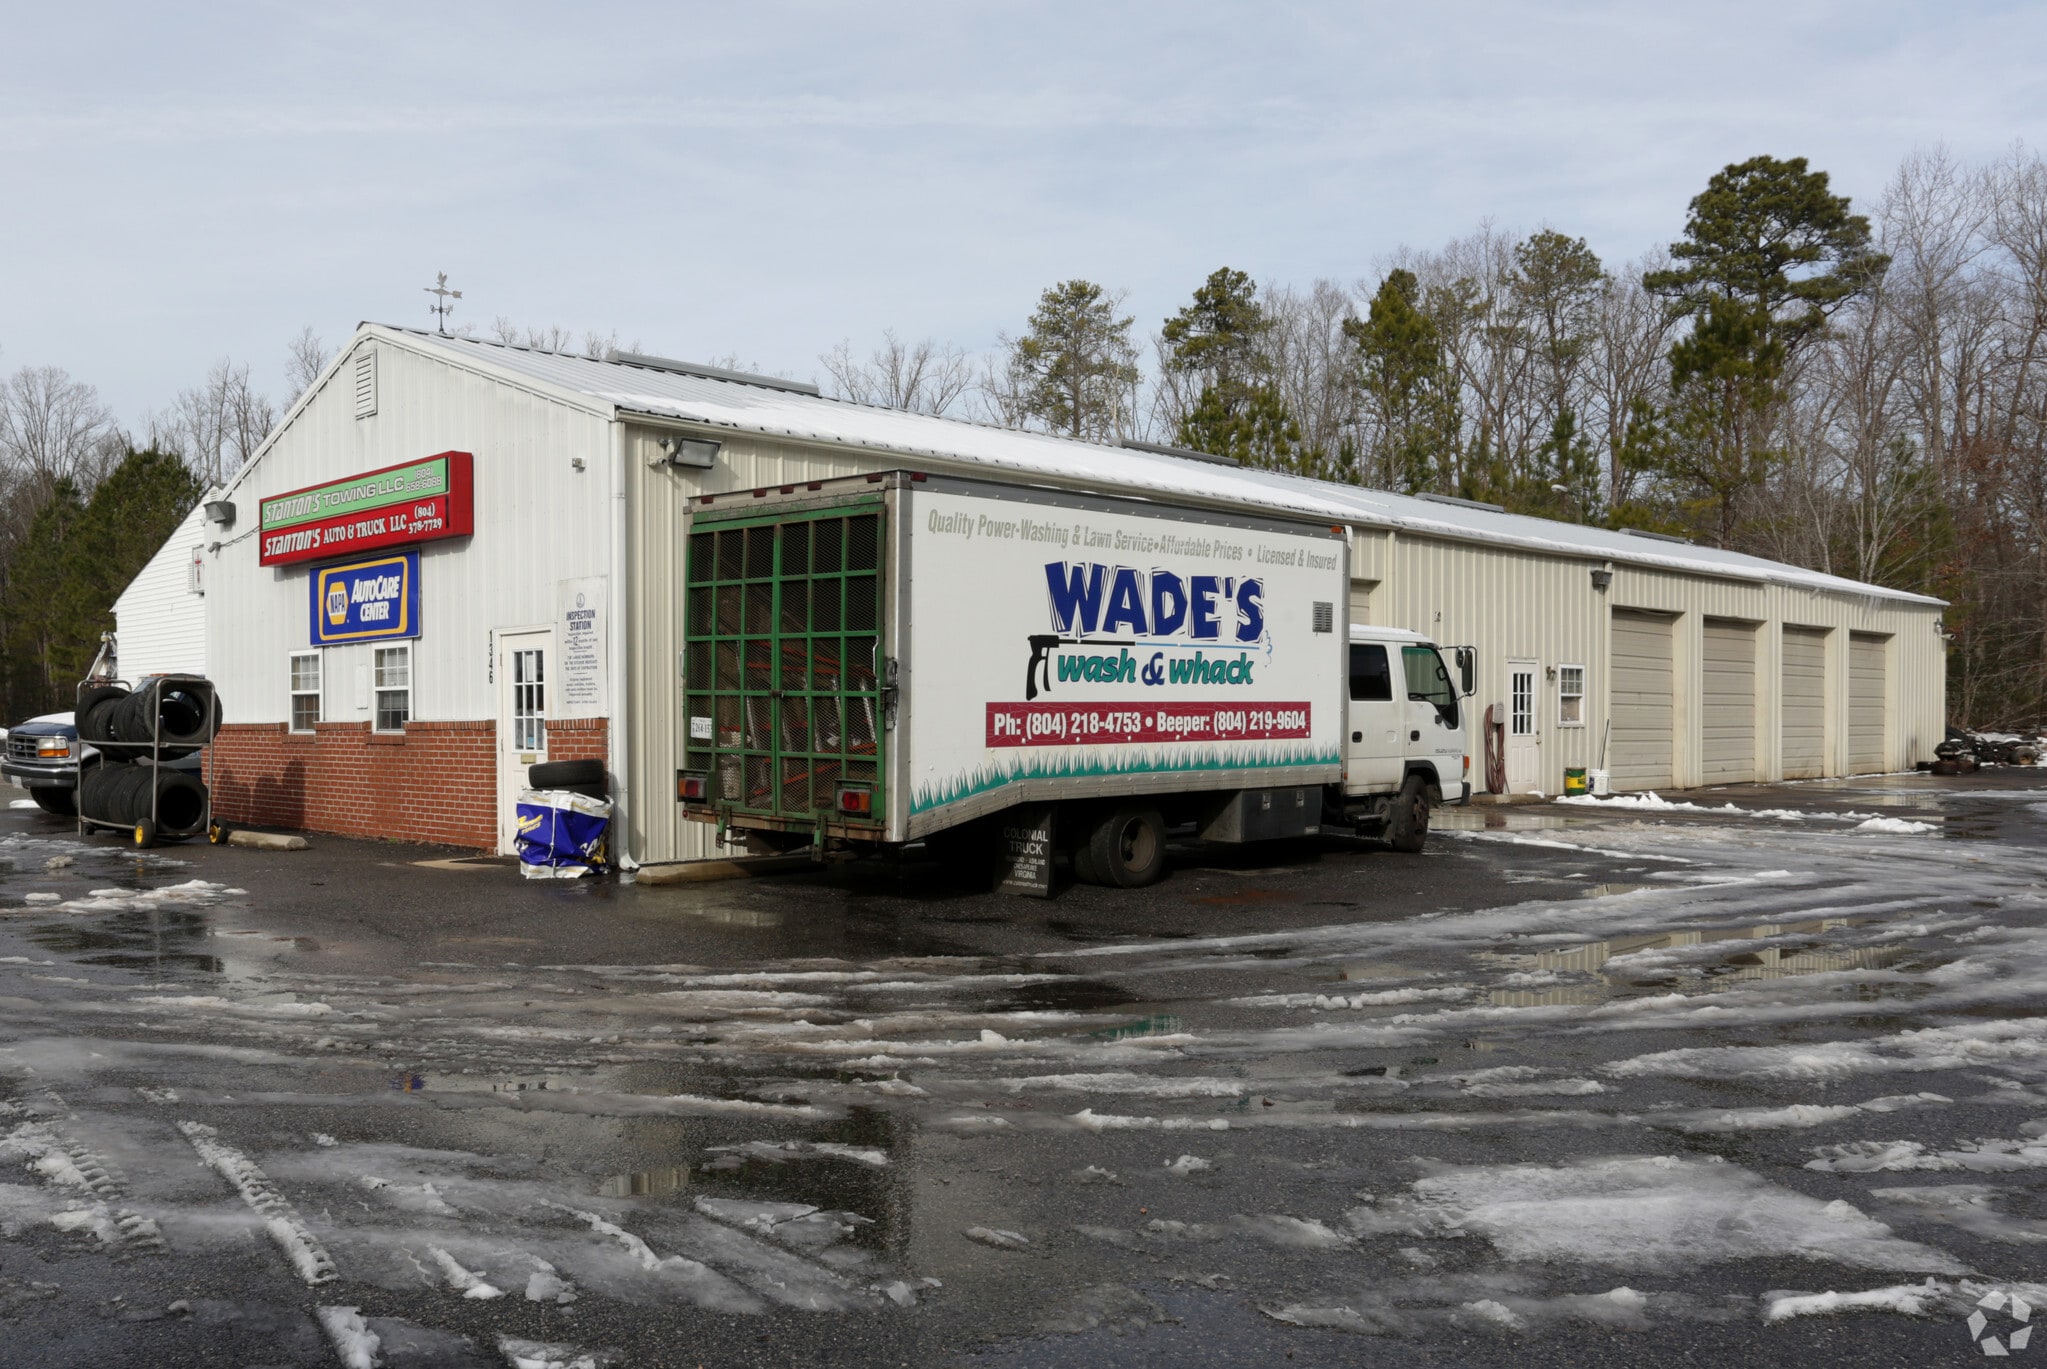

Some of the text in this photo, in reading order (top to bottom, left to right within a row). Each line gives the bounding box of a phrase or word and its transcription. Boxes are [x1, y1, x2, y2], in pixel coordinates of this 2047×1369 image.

[322, 484, 376, 507] TOWING
[378, 477, 405, 496] LLC
[414, 502, 435, 519] (804)
[323, 525, 345, 545] AUTO
[347, 524, 355, 539] &
[356, 517, 386, 539] TRUCK
[389, 514, 407, 532] LLC
[408, 518, 442, 534] 378-7729
[928, 508, 975, 540] Quality
[977, 514, 1069, 549] Power-Washing
[1072, 525, 1081, 546] &
[1083, 526, 1112, 549] Lawn
[1213, 540, 1243, 561] Prices
[1256, 544, 1296, 567] Licensed
[1297, 549, 1305, 567] &
[1307, 552, 1337, 571] Insured
[329, 593, 346, 614] NAPA
[360, 601, 390, 622] CENTER
[1045, 560, 1265, 643] WADE'S
[566, 609, 595, 621] INSPECTION
[569, 620, 592, 631] STATION
[1057, 648, 1254, 686] wash & whack
[994, 710, 1306, 739] Ph: (804) 218-4753 Beeper: (804) 219-9604
[1003, 827, 1049, 842] COLONIAL
[1009, 840, 1043, 855] TRUCK
